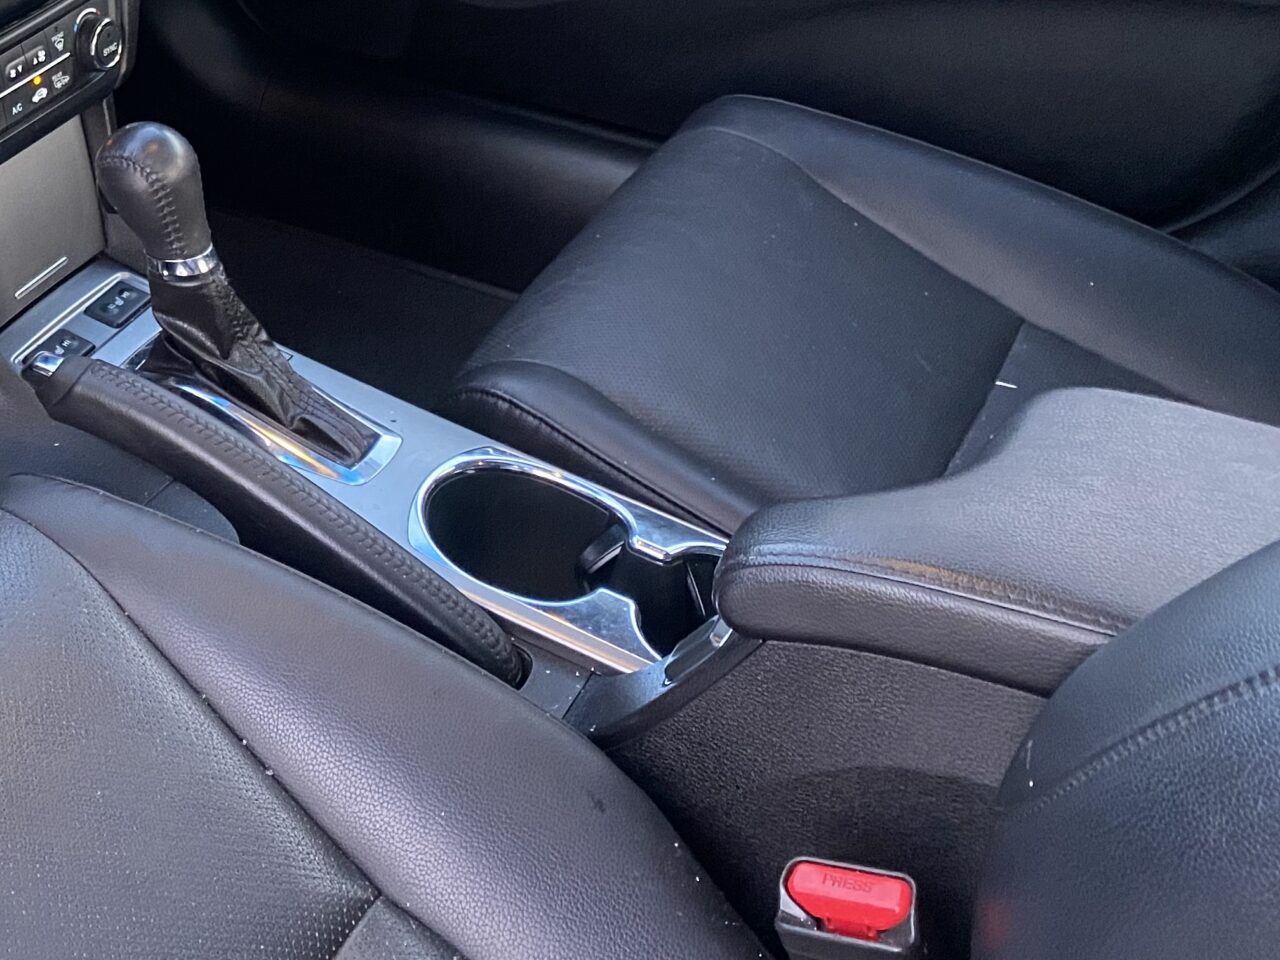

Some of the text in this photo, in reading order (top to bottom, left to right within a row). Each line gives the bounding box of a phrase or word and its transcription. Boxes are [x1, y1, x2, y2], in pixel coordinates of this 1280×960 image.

[103, 42, 118, 57] SYNC
[12, 102, 23, 115] A/C
[822, 872, 875, 893] PRESS
